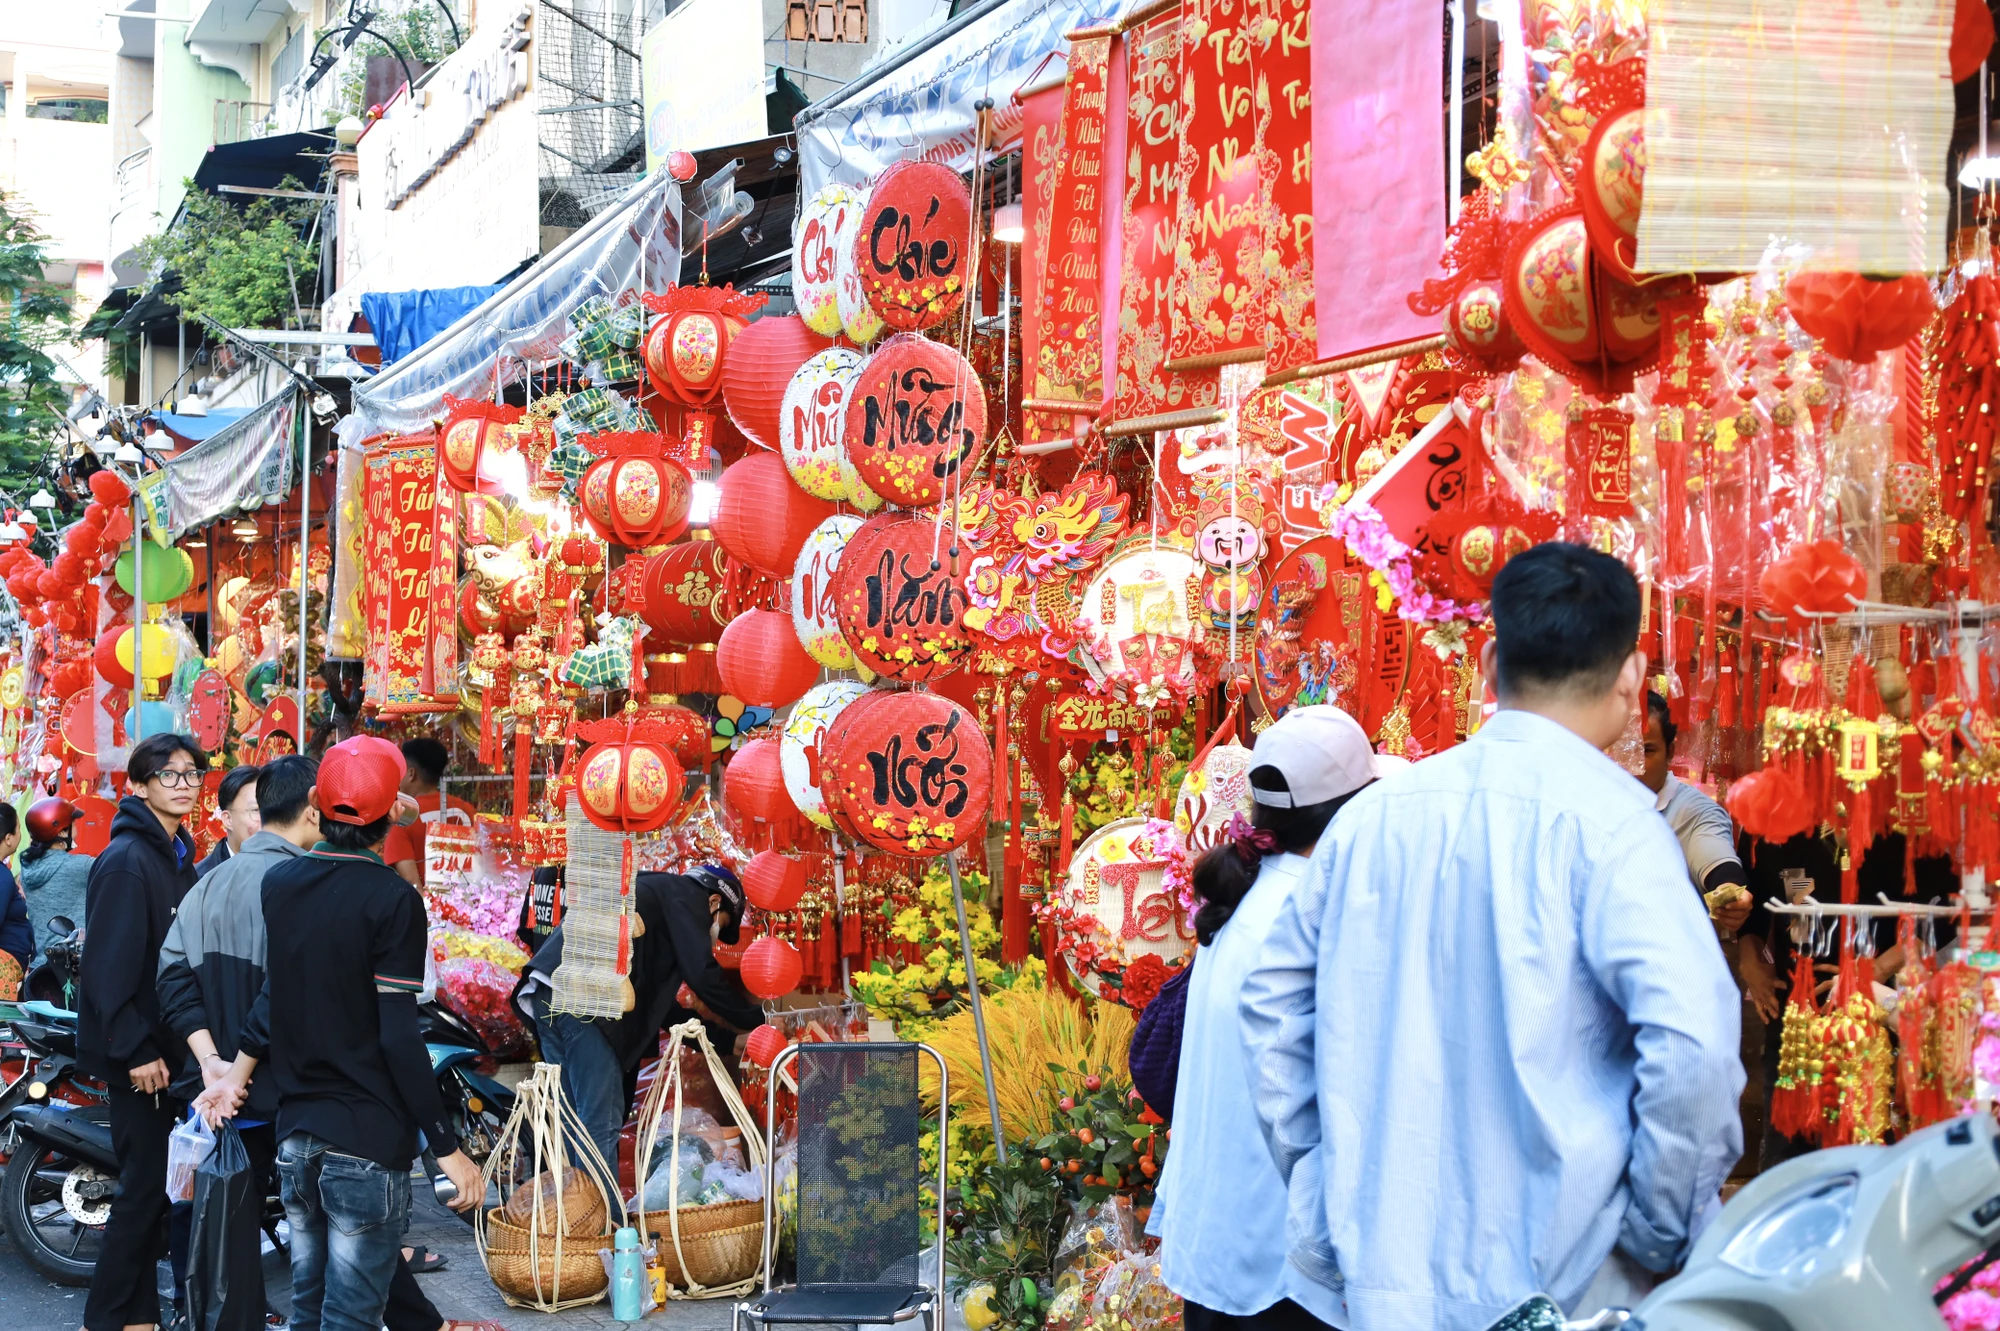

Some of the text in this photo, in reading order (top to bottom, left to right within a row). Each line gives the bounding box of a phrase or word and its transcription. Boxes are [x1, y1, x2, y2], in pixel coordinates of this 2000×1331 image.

[1075, 116, 1101, 144] Nhà
[1067, 217, 1097, 244] Đón
[1059, 252, 1098, 280] Vinh
[1060, 285, 1094, 313] Hoa
[1465, 304, 1492, 330] 福
[1281, 391, 1330, 549] EW
[403, 522, 432, 554] Tà
[676, 570, 713, 607] 福
